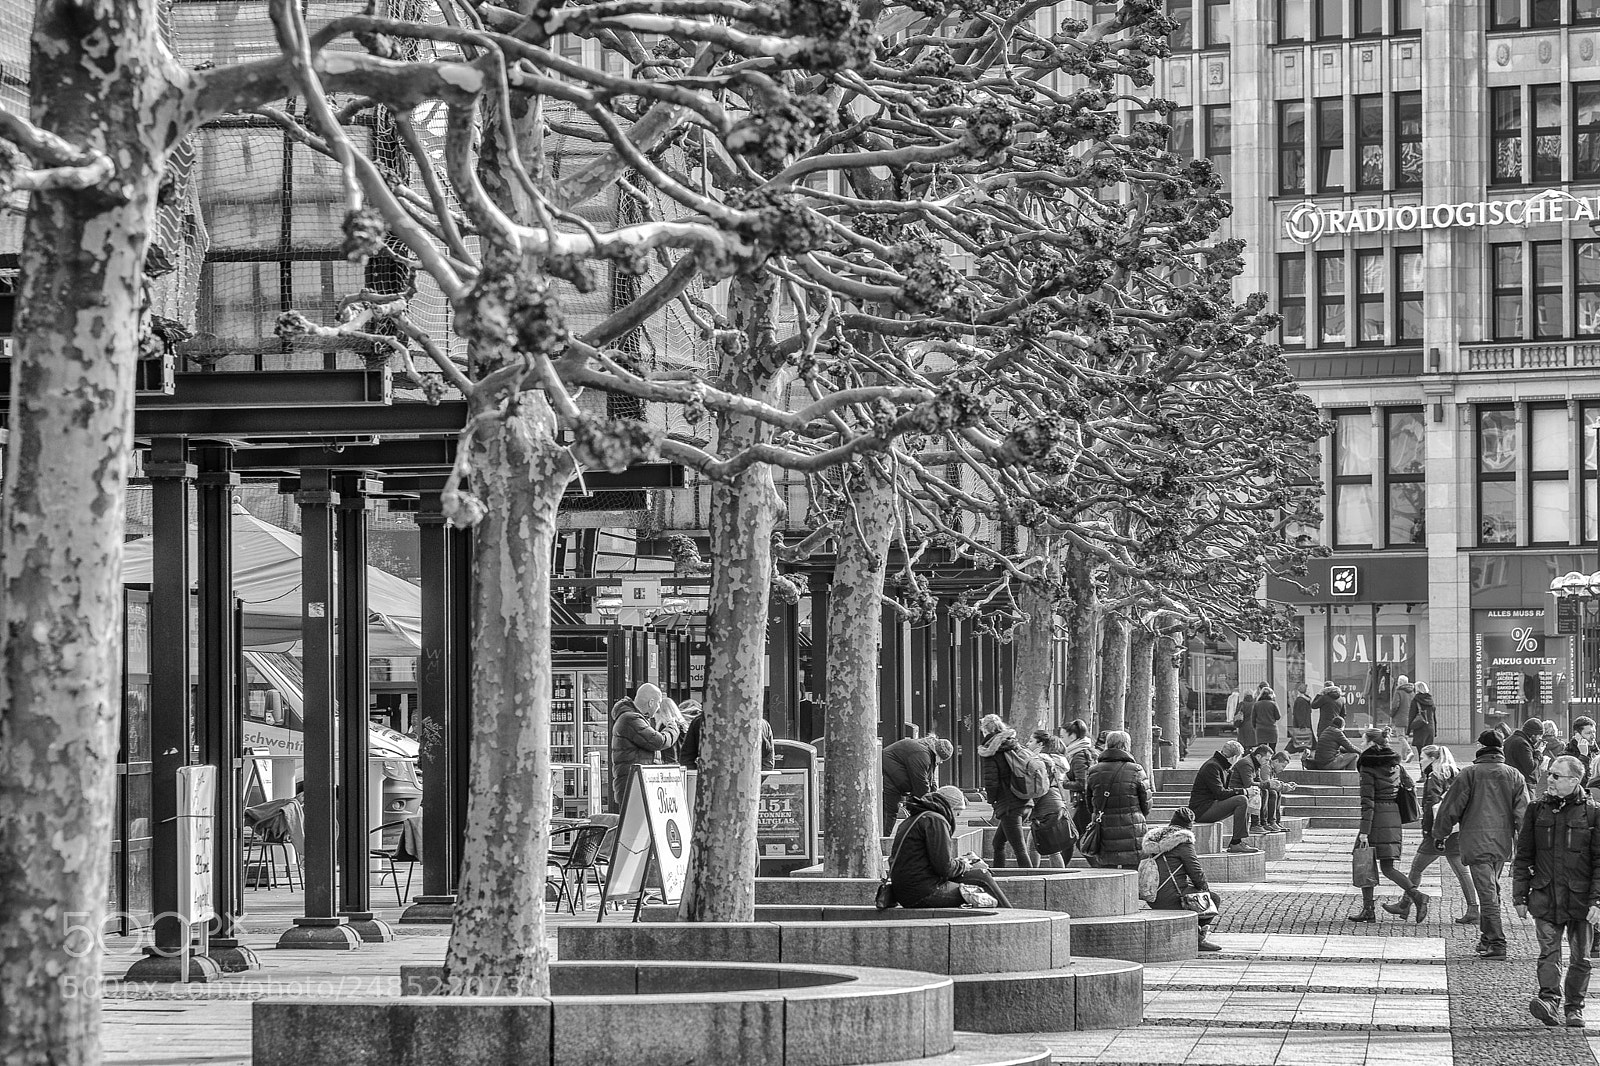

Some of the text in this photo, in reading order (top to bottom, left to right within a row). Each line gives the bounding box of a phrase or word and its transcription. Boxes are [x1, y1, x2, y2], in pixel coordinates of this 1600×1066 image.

[1329, 195, 1600, 234] RADIOLOGISCHE A
[1332, 634, 1408, 663] SALE
[1511, 627, 1538, 652] %
[1492, 657, 1558, 666] ANZUG OUTLET
[1475, 663, 1483, 687] MUSS
[1475, 688, 1483, 714] ALLES
[657, 787, 678, 814] Bier
[759, 799, 792, 812] 151
